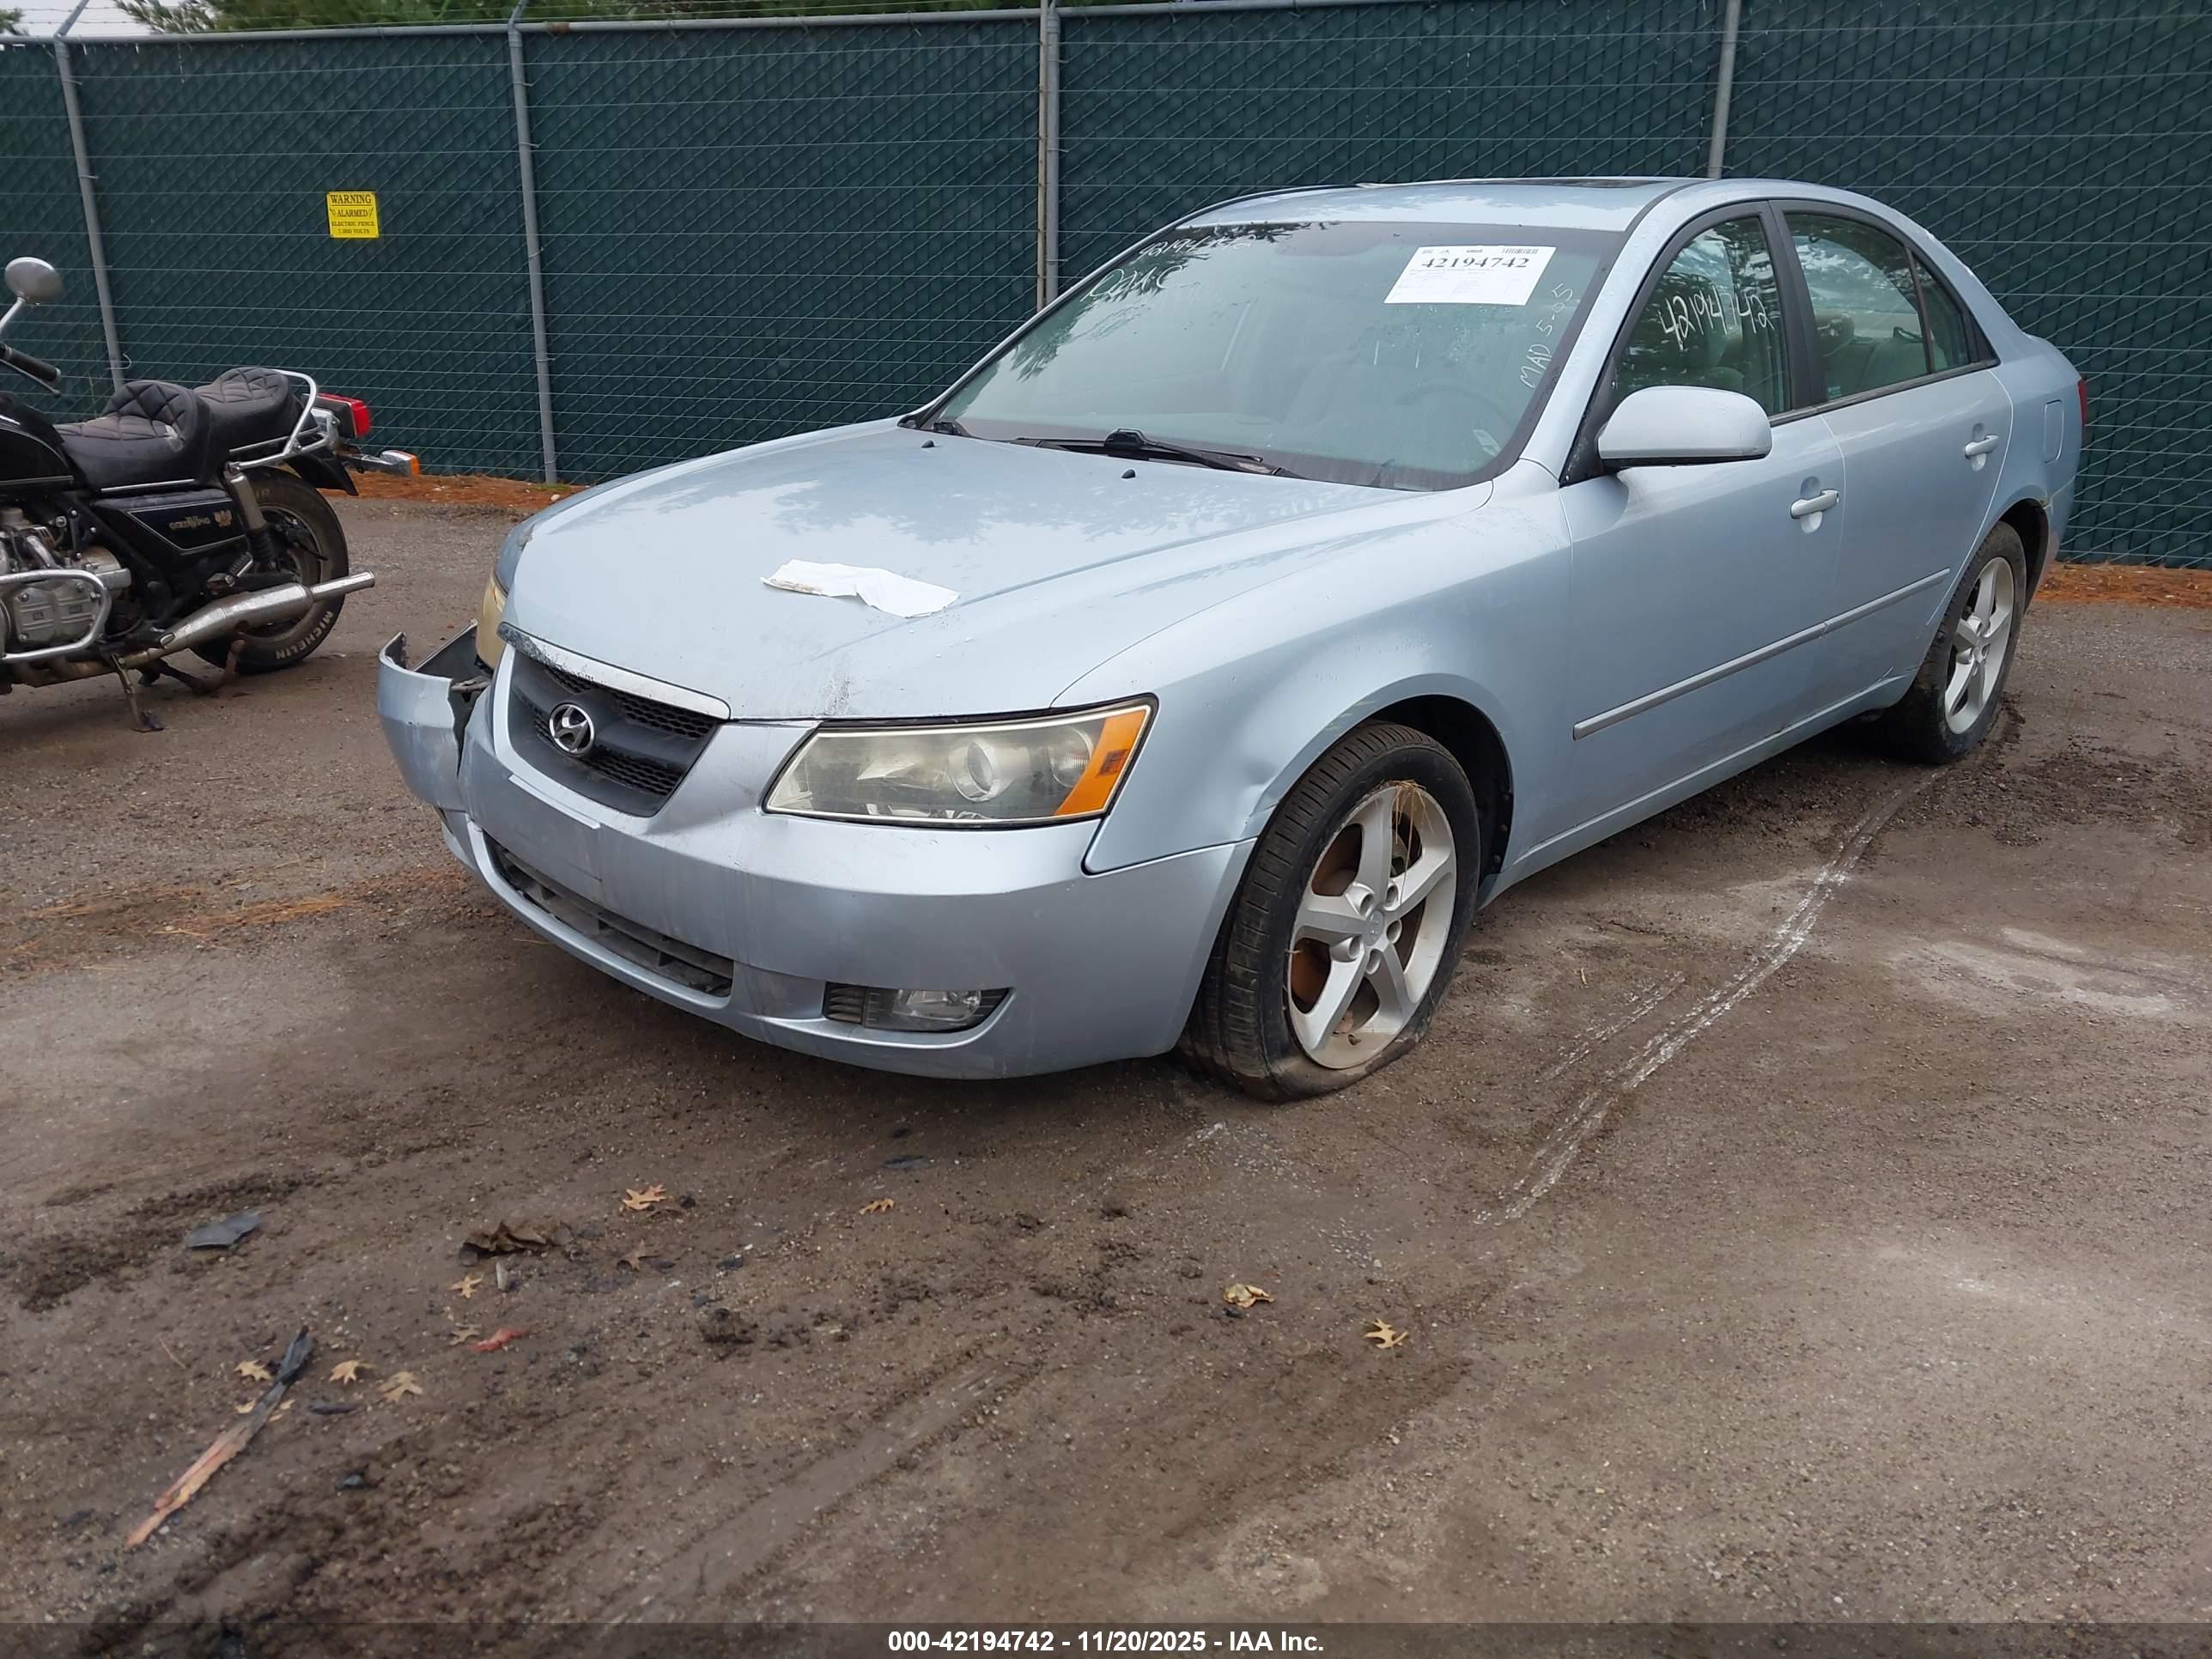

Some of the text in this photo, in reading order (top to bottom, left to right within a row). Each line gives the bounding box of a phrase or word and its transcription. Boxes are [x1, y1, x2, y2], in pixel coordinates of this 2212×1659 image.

[330, 194, 372, 204] WARNING
[337, 209, 368, 217] ALARMED
[1421, 257, 1530, 268] 42194742
[1658, 285, 1775, 350] 42194742
[1520, 343, 1553, 388] MAD
[276, 611, 334, 660] MICHELIN
